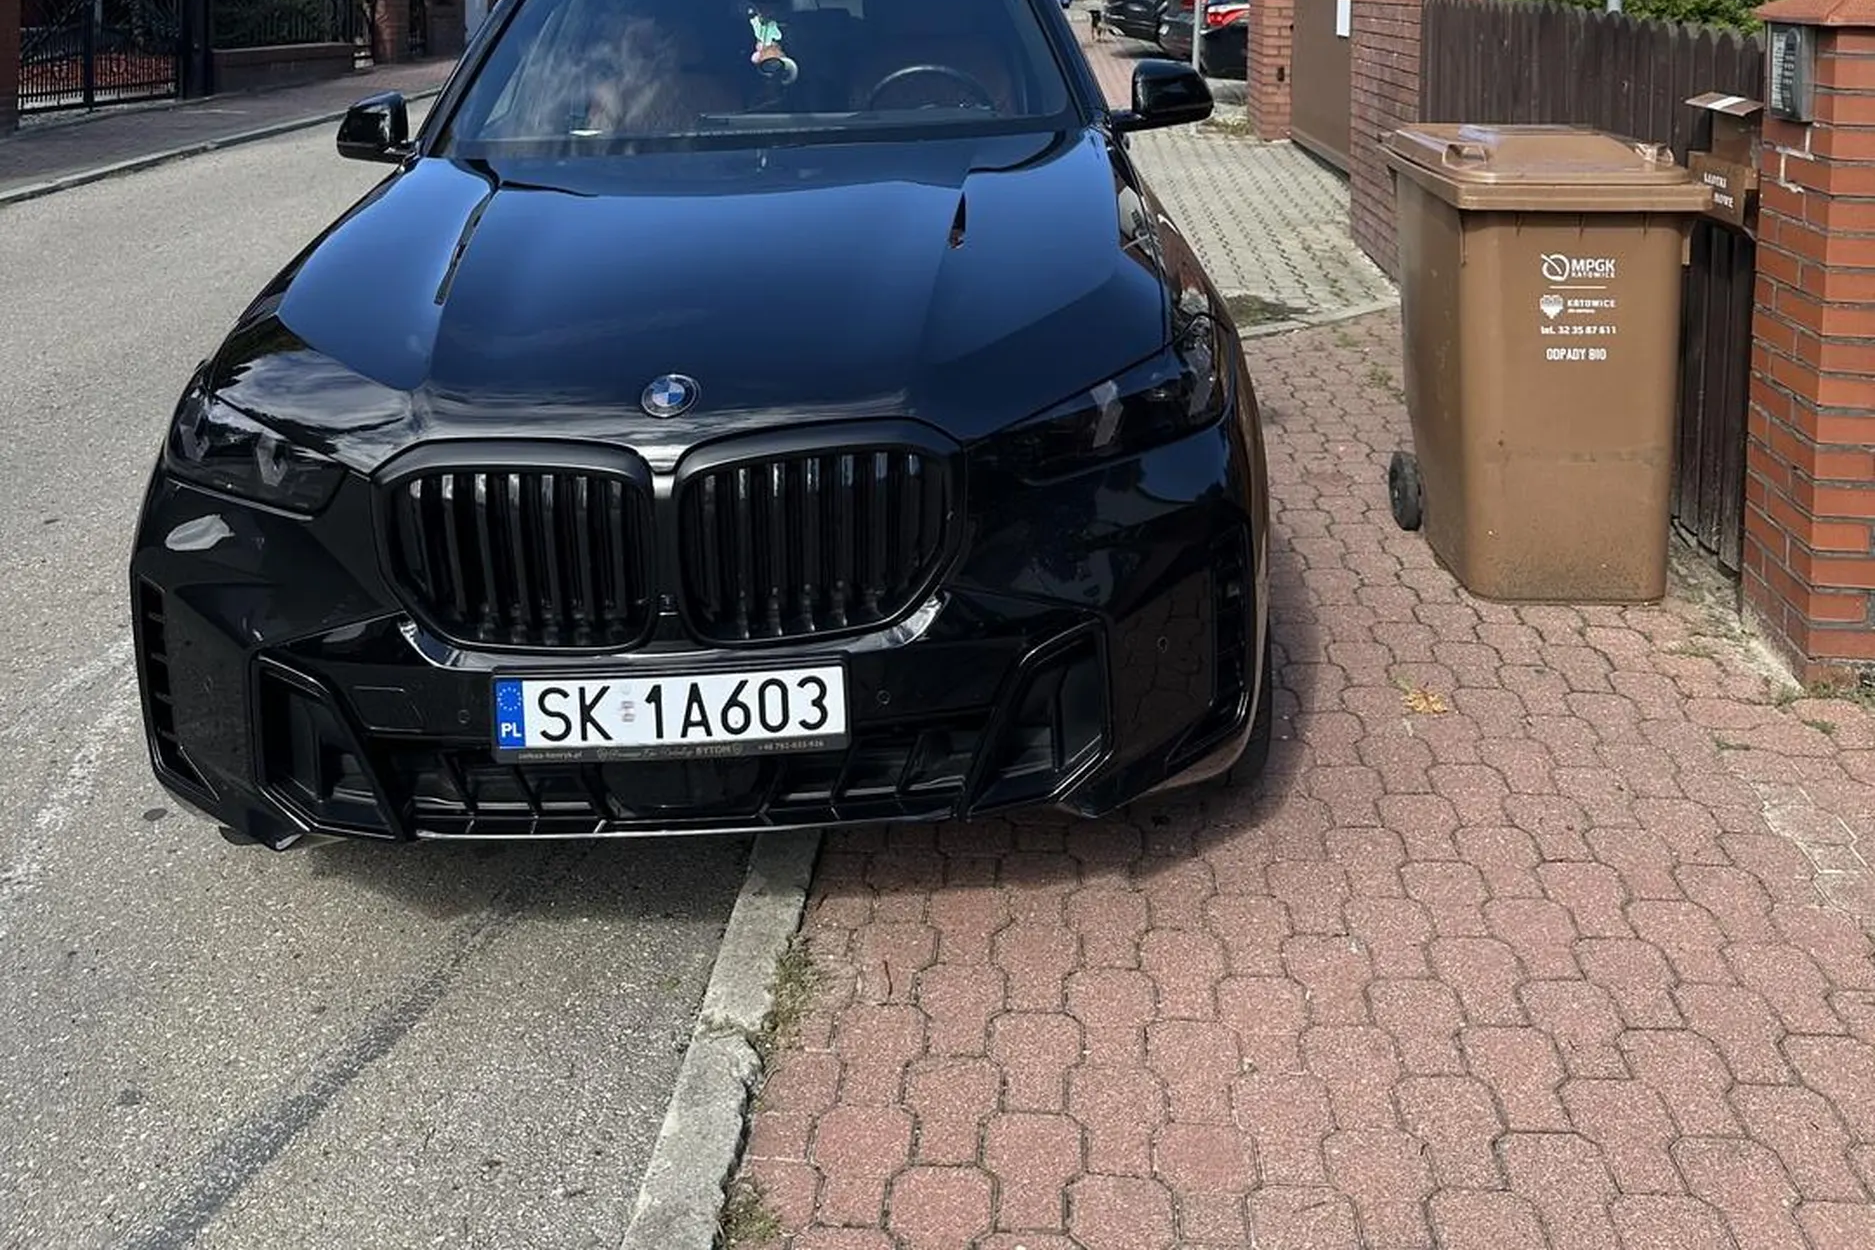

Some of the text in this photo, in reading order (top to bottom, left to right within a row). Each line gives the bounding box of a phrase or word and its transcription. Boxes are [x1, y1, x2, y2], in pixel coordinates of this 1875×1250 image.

[1571, 259, 1616, 271] MPGK
[1567, 299, 1616, 307] KATOWICE
[1546, 348, 1607, 360] ODPADY BIO
[537, 675, 829, 742] SK 1A603
[501, 722, 522, 738] PL
